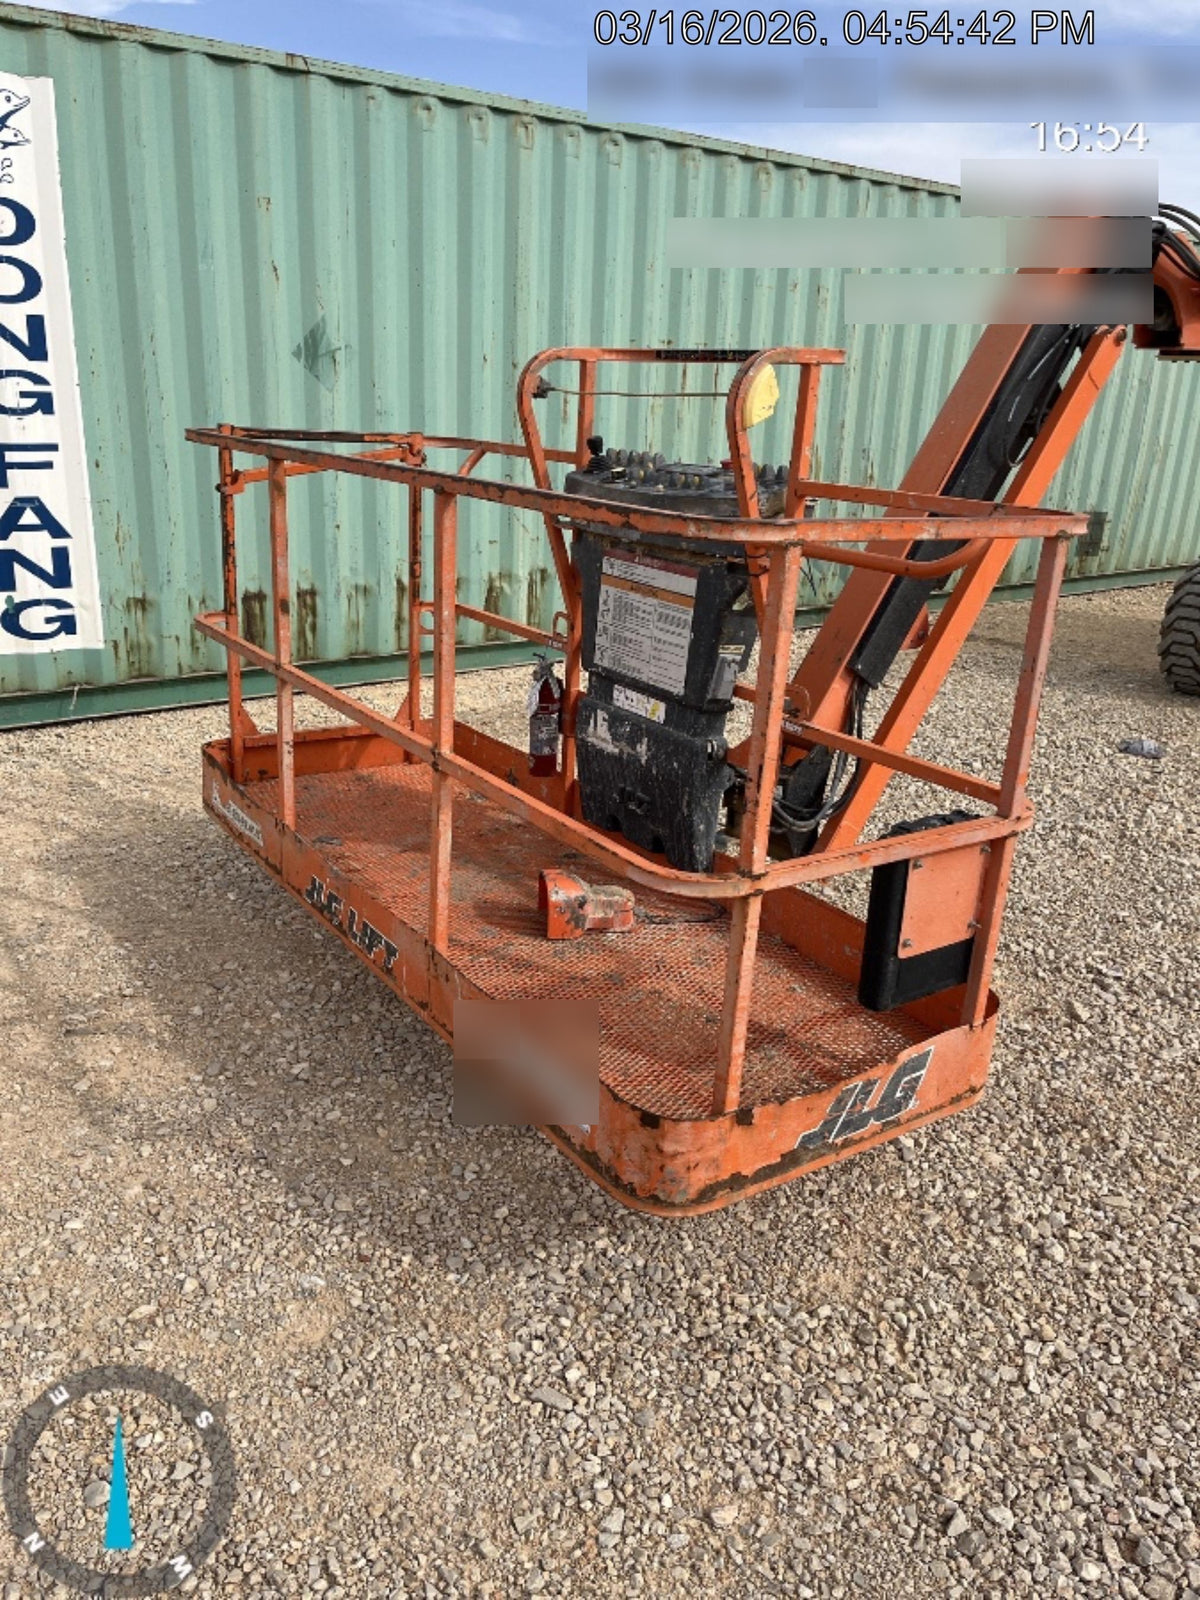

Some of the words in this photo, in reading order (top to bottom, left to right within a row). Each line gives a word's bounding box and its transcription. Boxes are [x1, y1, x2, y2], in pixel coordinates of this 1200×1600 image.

[0, 443, 77, 640] FANG
[304, 874, 345, 926] JLG
[348, 906, 398, 968] LIFT
[794, 1045, 935, 1148] JLG
